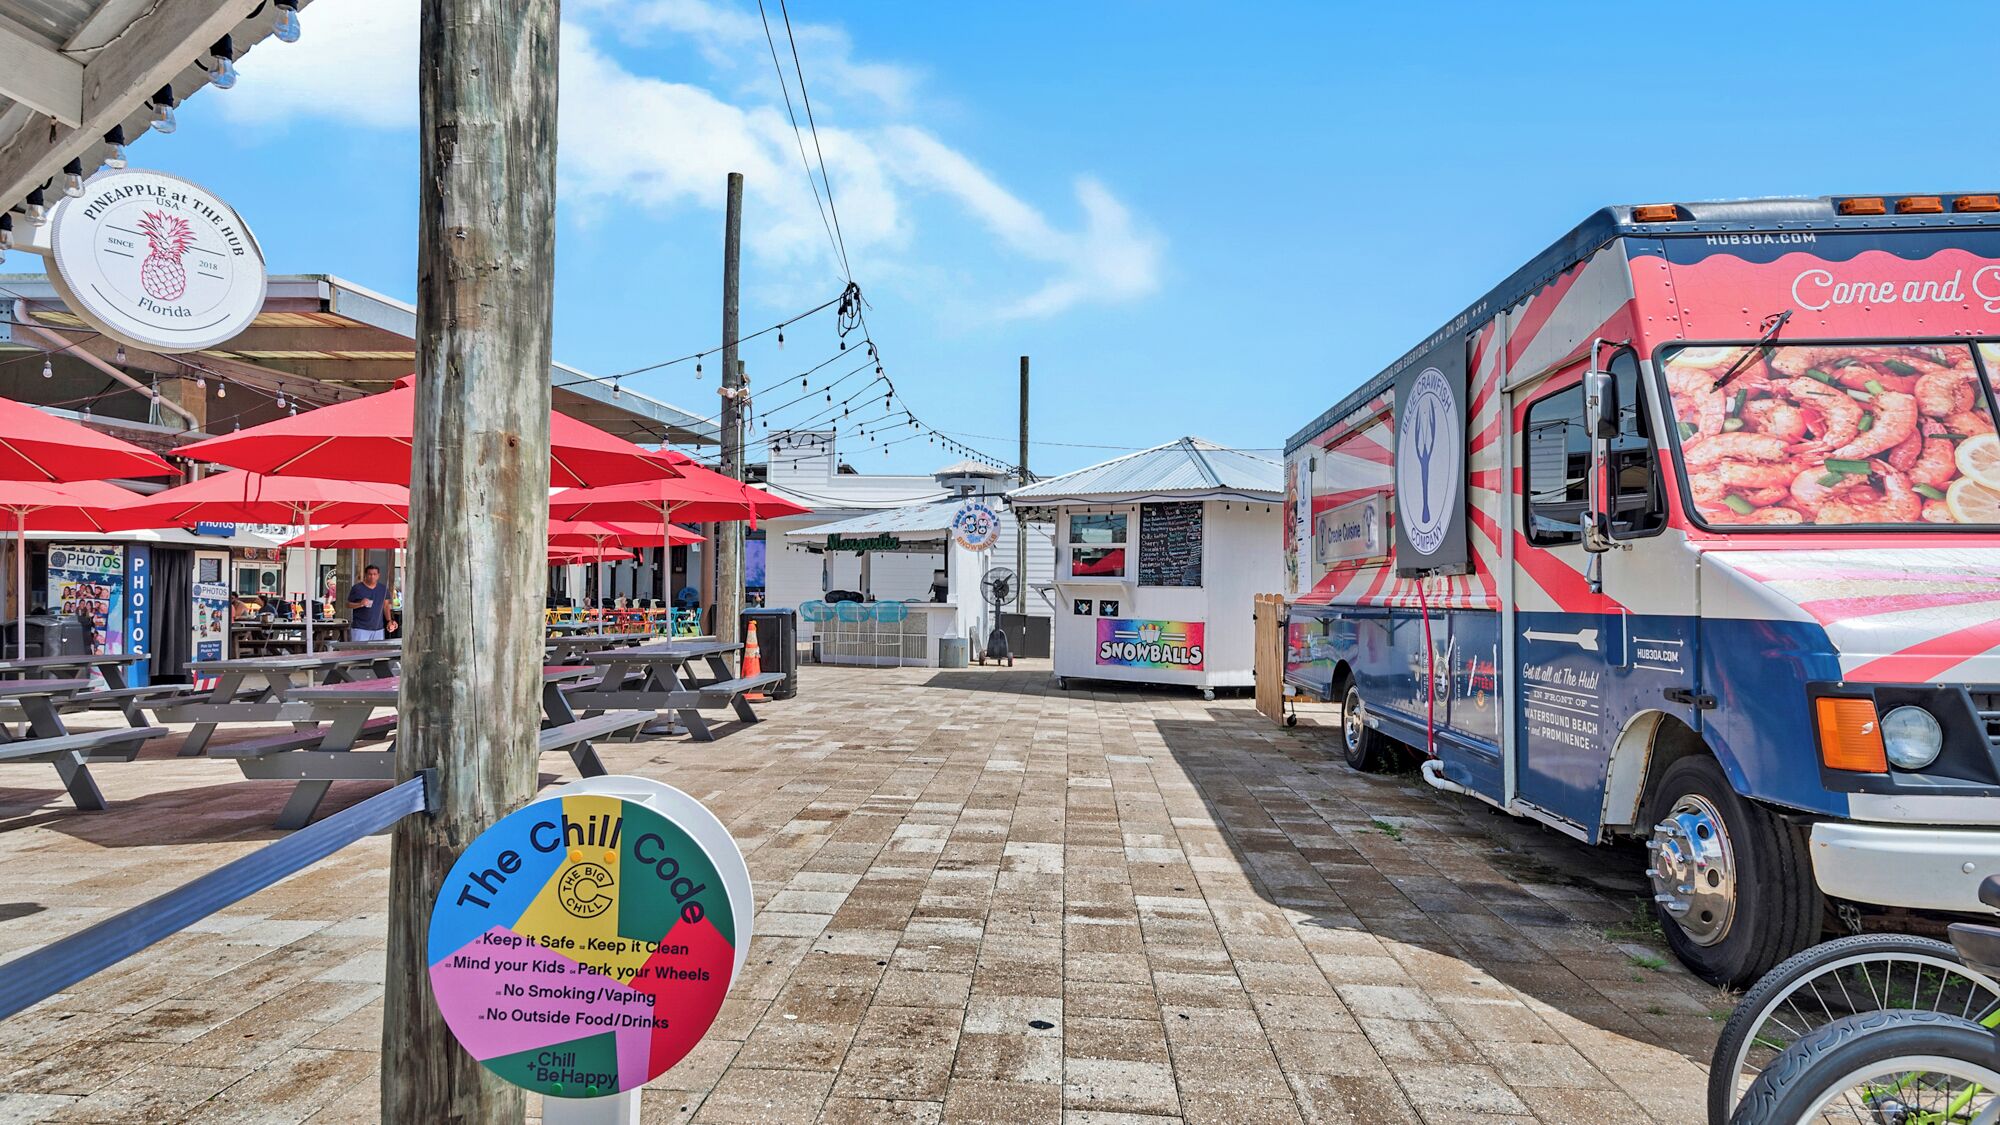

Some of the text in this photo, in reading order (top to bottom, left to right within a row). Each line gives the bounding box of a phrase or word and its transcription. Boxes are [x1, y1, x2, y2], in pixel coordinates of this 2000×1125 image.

[156, 197, 180, 211] USA
[84, 184, 245, 257] PINEAPPLE at THE HUB
[108, 237, 134, 249] SINCE
[1706, 233, 1817, 246] HUB30A.COM
[199, 260, 218, 271] 2018
[1791, 268, 1898, 311] Come
[1901, 269, 1965, 305] and
[137, 297, 192, 318] Florida
[1445, 321, 1455, 338] ON
[1402, 390, 1417, 434] BLUE
[1417, 373, 1452, 413] CRAWFISH
[1343, 521, 1360, 541] Cuisine
[1411, 521, 1443, 550] COMPANY
[67, 553, 121, 569] PHOTOS
[202, 586, 228, 596] PHOTOS
[132, 558, 145, 655] PHOTOS
[1099, 640, 1204, 666] SNOWBALLS
[1637, 648, 1679, 663] HUB30A.COM
[1522, 662, 1600, 690] Get it all at The Hub!
[1533, 690, 1588, 708] IN FRONT OF
[1524, 707, 1598, 735] WATERSOUND BEACH
[1541, 726, 1590, 750] PROMINENCE
[456, 814, 706, 925] The Chill Code
[563, 867, 605, 892] THE BIG
[566, 897, 603, 914] CHILL
[483, 932, 523, 950] Keep
[526, 934, 536, 947] it
[540, 935, 575, 949] Safe
[587, 938, 626, 955] Keep
[631, 940, 641, 952] it
[645, 941, 689, 955] Clean
[453, 956, 491, 970] Mind
[494, 959, 529, 974] your
[532, 960, 566, 974] Kids
[578, 962, 612, 976] Park
[616, 966, 650, 980] your
[655, 966, 710, 981] Wheels
[503, 983, 525, 997] No
[528, 985, 656, 1007] Smoking/Vaping
[486, 1008, 508, 1021] No
[511, 1009, 571, 1024] Outside
[575, 1012, 669, 1029] Food/Drinks
[537, 1051, 576, 1068] Chill
